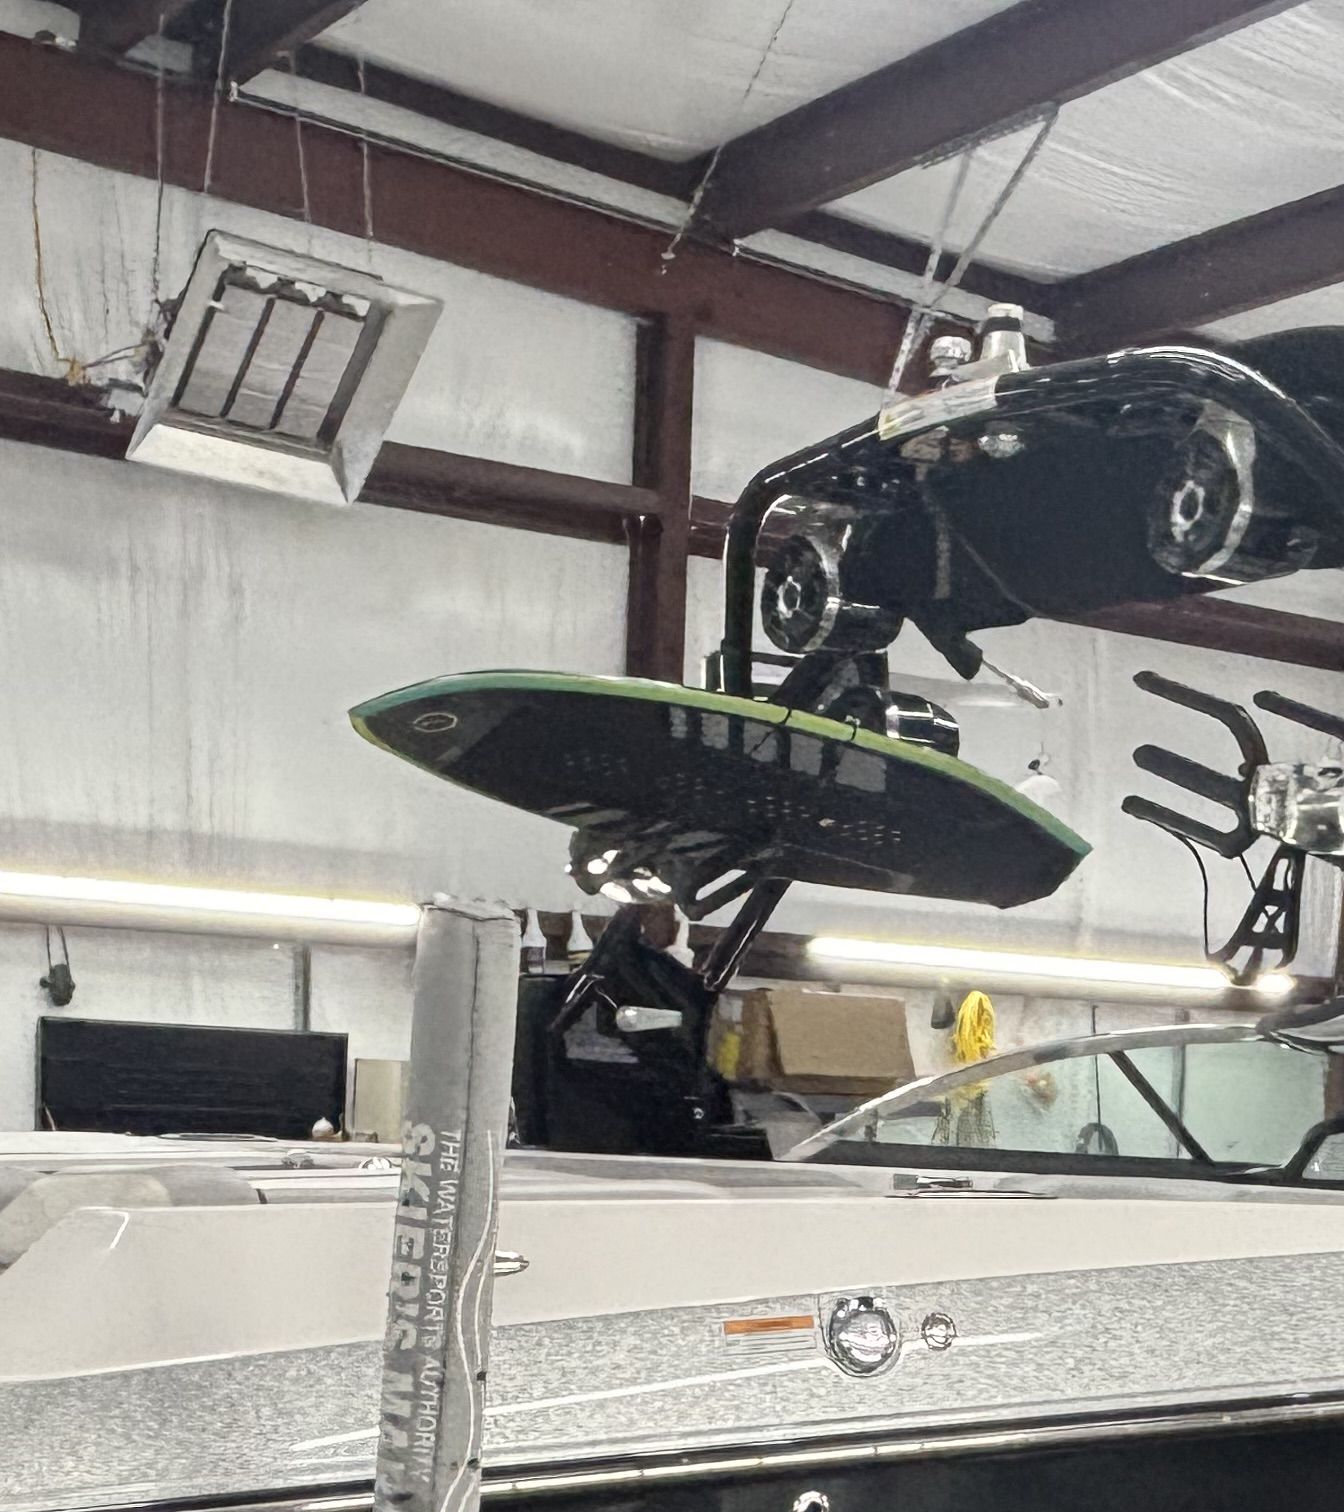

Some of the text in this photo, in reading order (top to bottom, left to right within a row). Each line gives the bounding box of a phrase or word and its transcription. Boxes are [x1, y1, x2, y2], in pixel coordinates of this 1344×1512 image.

[408, 1128, 462, 1484] THE WATERSPORTS AUTHORITY
